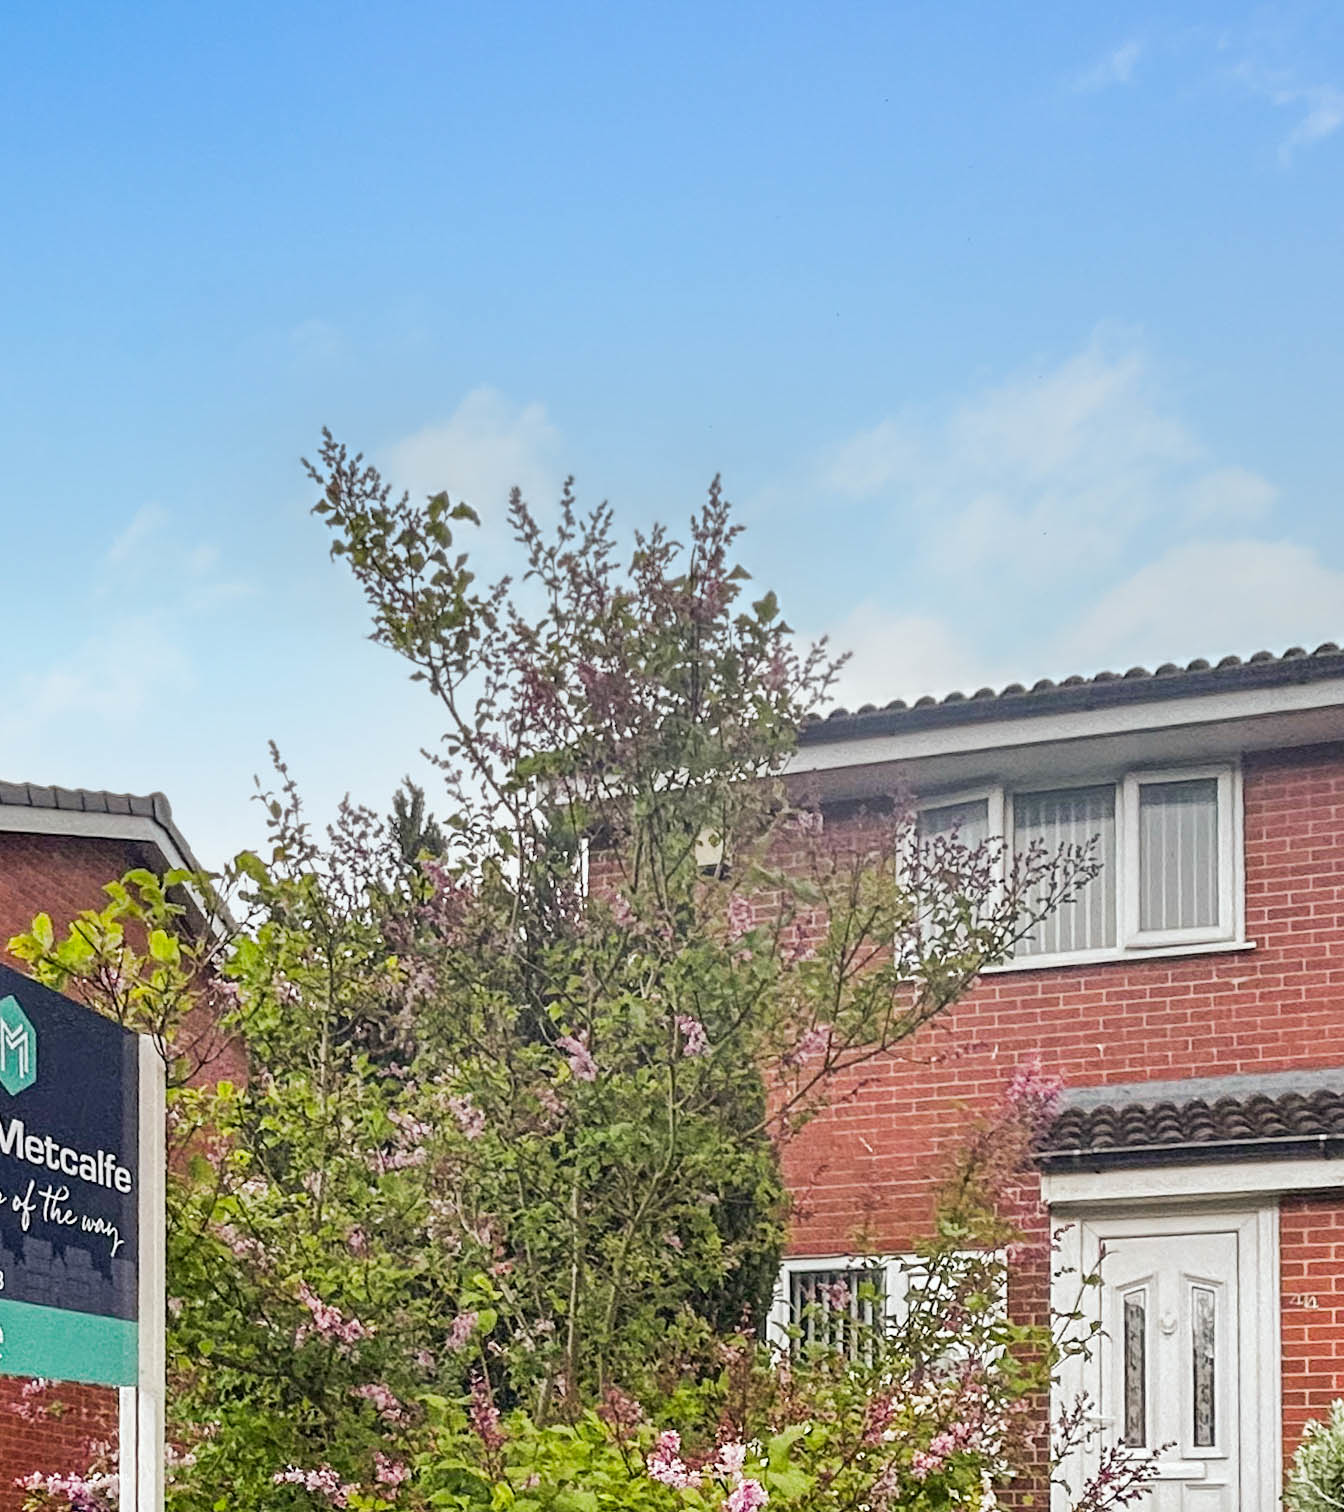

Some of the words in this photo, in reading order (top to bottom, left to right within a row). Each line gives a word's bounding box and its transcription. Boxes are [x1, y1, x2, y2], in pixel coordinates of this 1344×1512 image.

[11, 1178, 37, 1232] of
[37, 1184, 78, 1225] the
[81, 1214, 126, 1258] way
